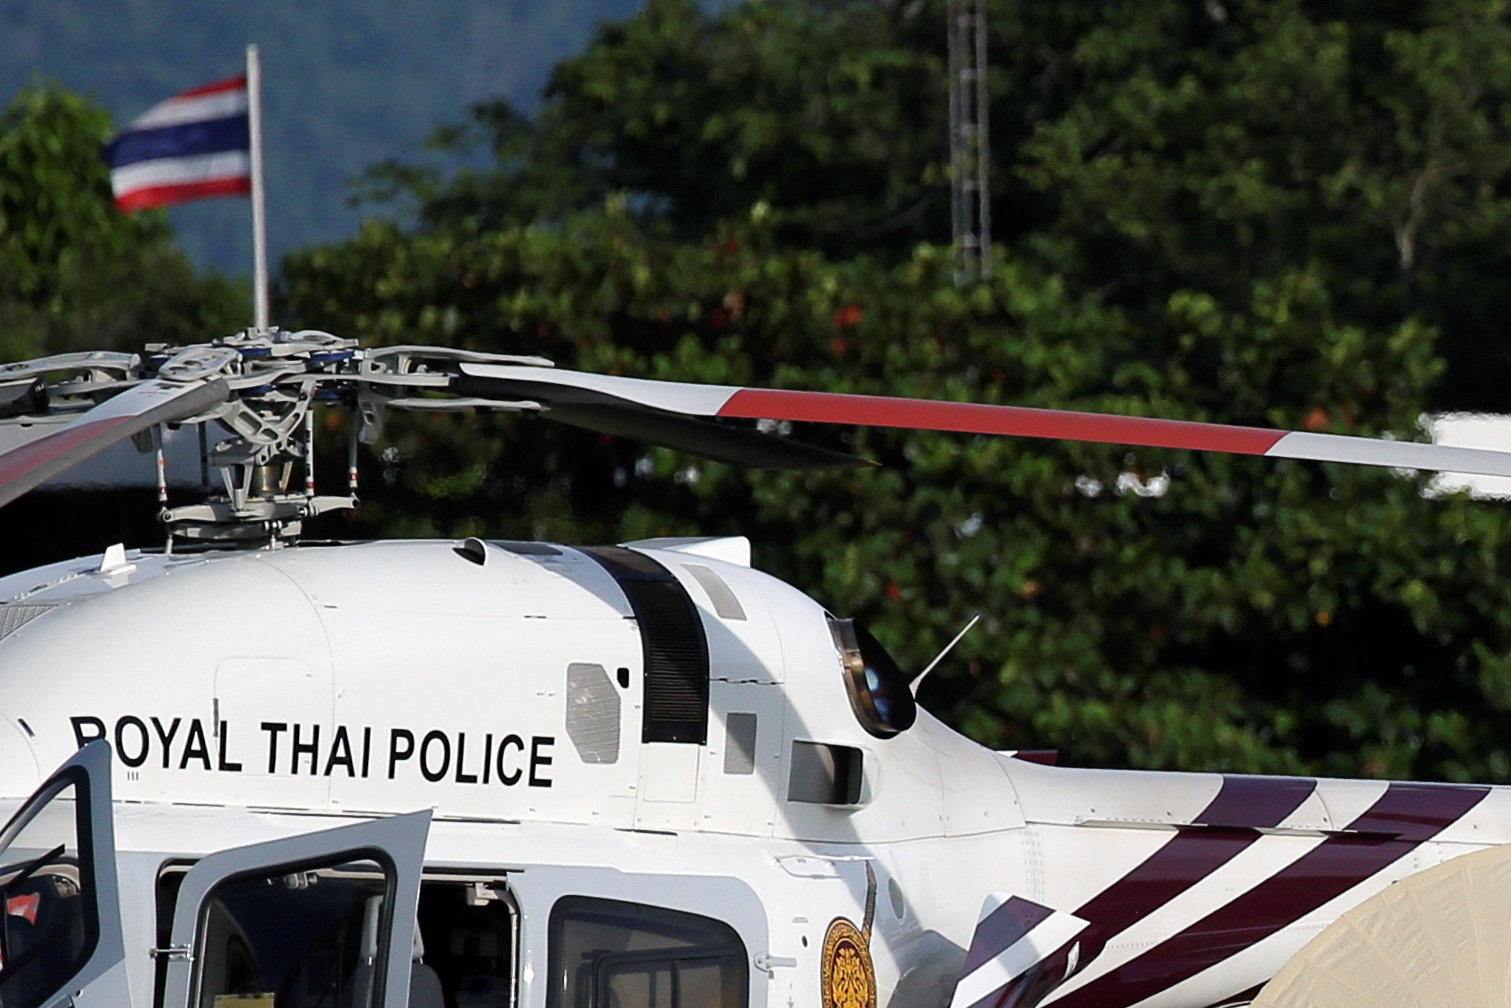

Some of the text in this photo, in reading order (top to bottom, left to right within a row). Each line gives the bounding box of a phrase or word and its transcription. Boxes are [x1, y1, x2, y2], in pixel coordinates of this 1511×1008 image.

[69, 714, 556, 788] ROYAL THAI POLICE
